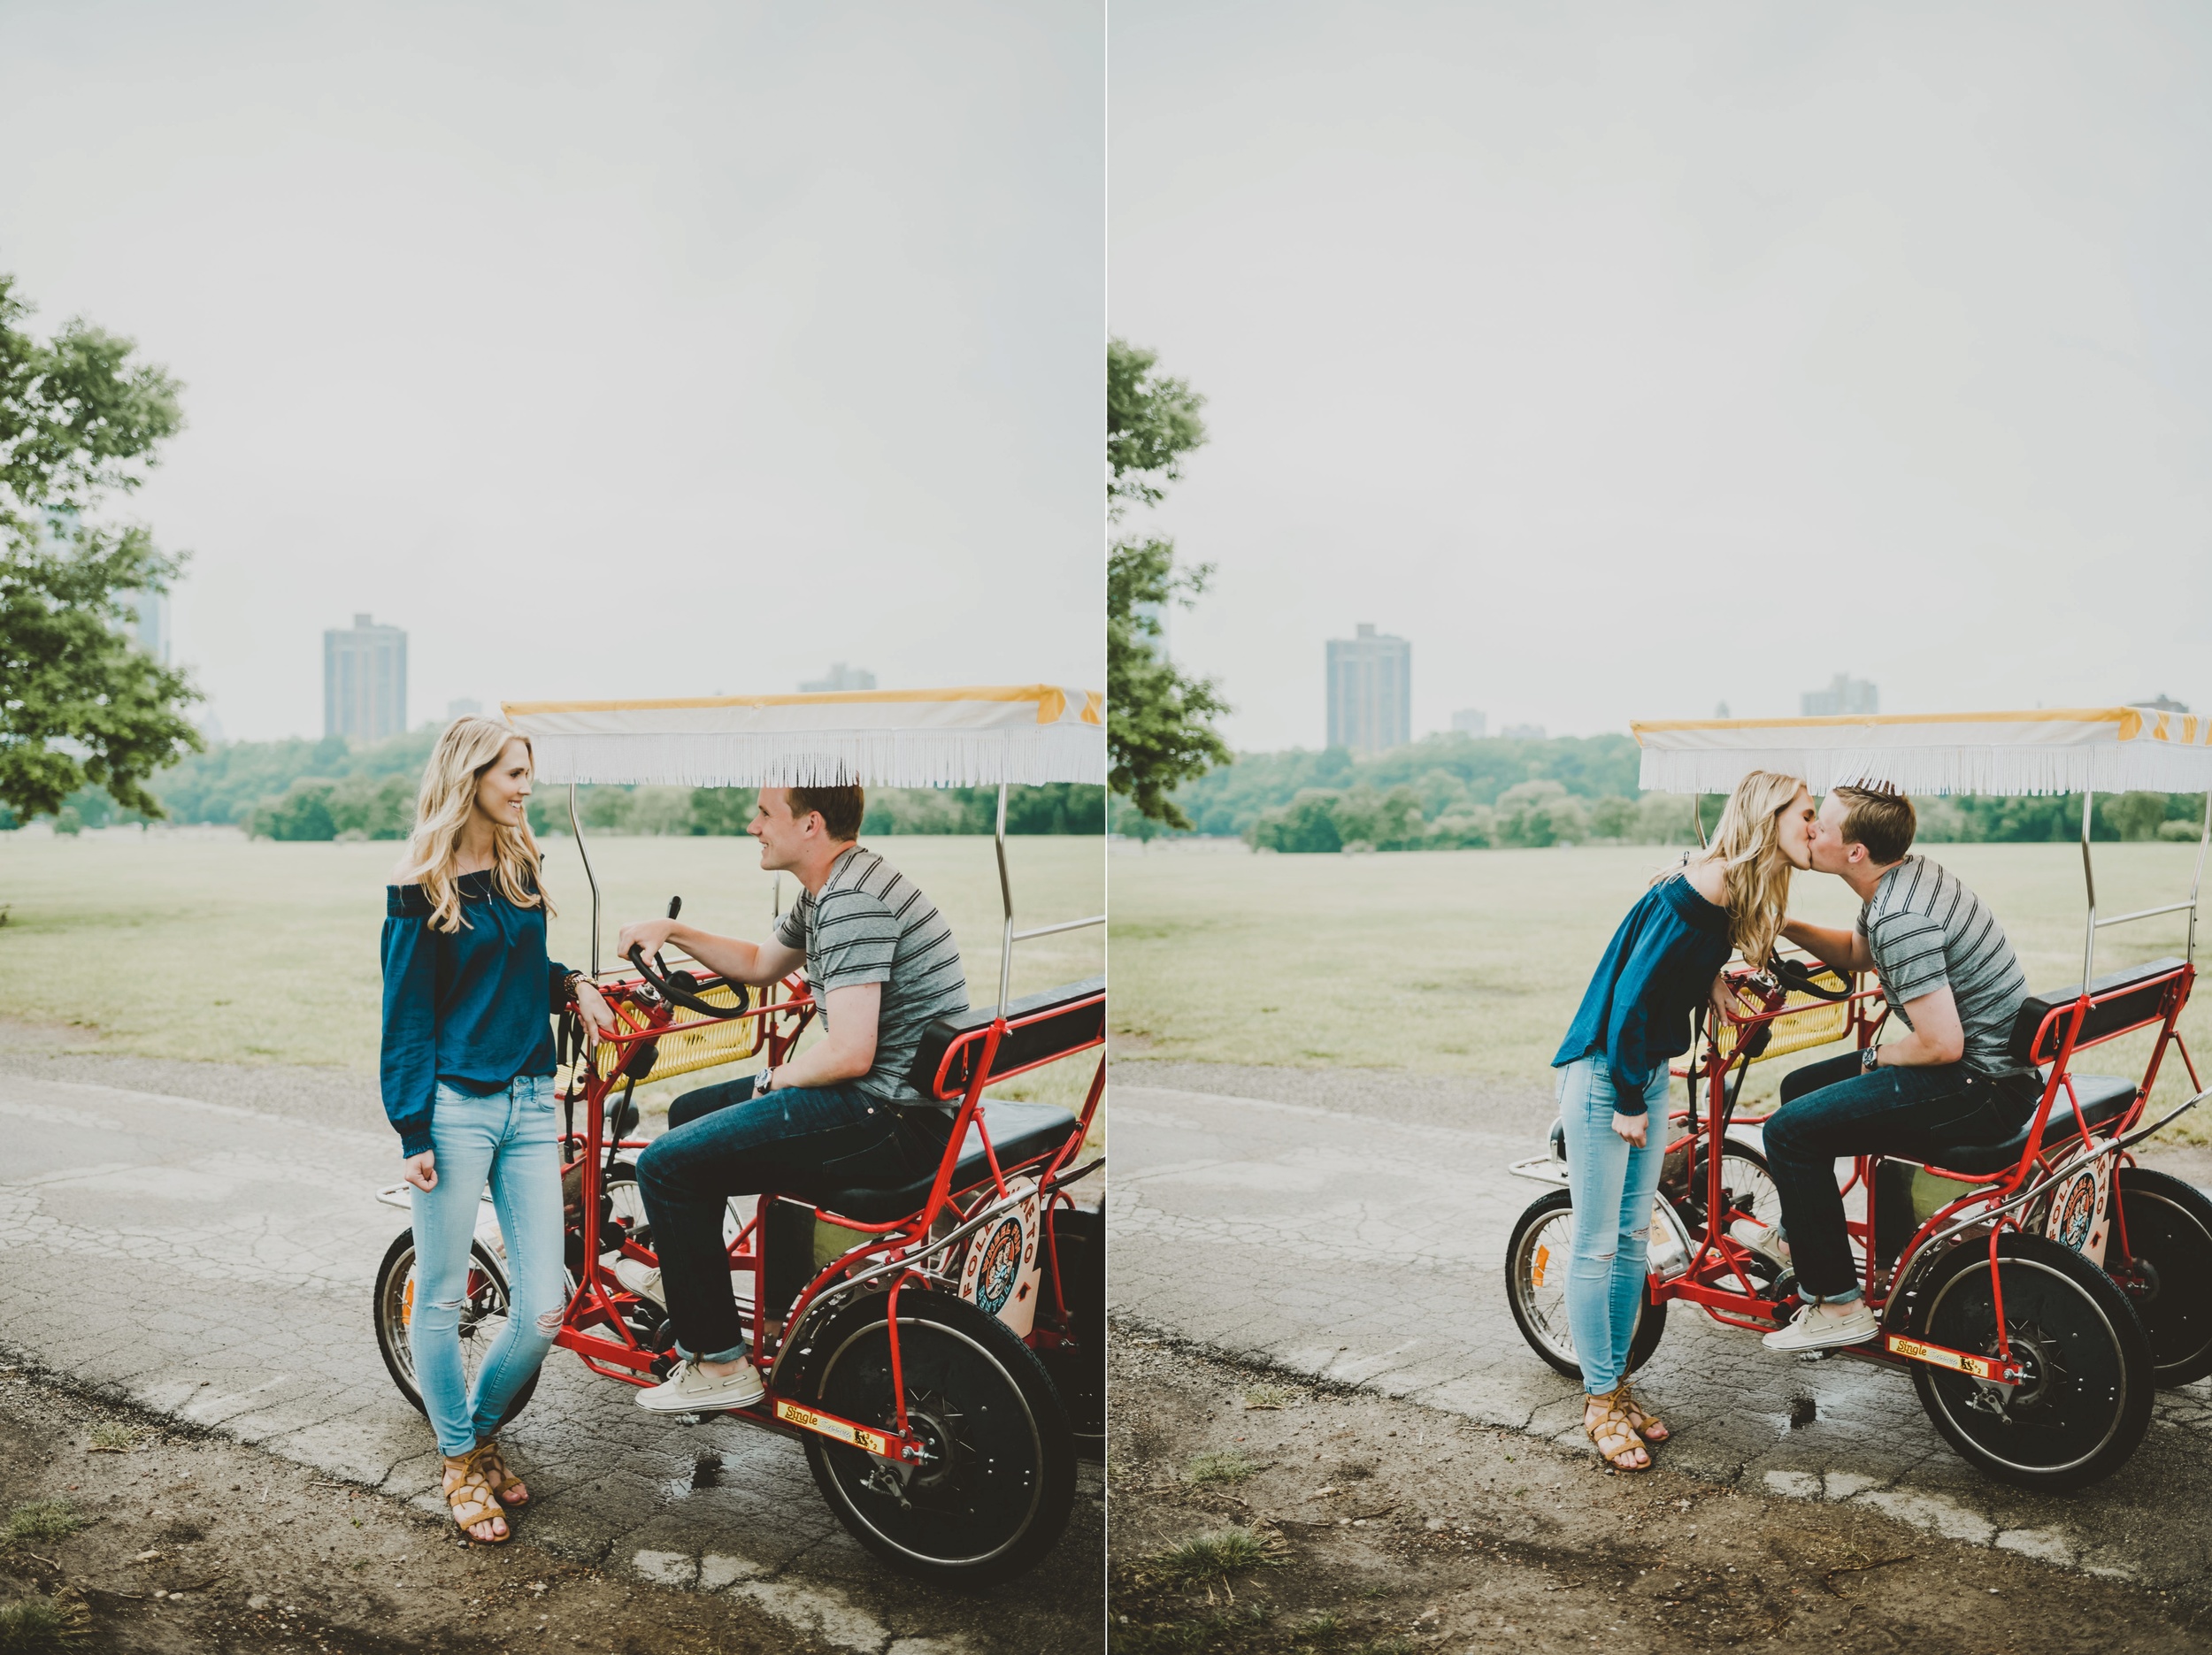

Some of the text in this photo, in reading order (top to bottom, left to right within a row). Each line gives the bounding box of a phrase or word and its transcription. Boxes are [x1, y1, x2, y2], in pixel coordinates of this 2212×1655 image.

[2062, 1176, 2087, 1222] WHEEL
[2096, 1177, 2106, 1215] TO
[981, 1222, 1021, 1274] WHEEL FUN
[1024, 1222, 1036, 1264] TO
[1896, 1340, 1927, 1356] Single
[785, 1406, 818, 1425] Single
